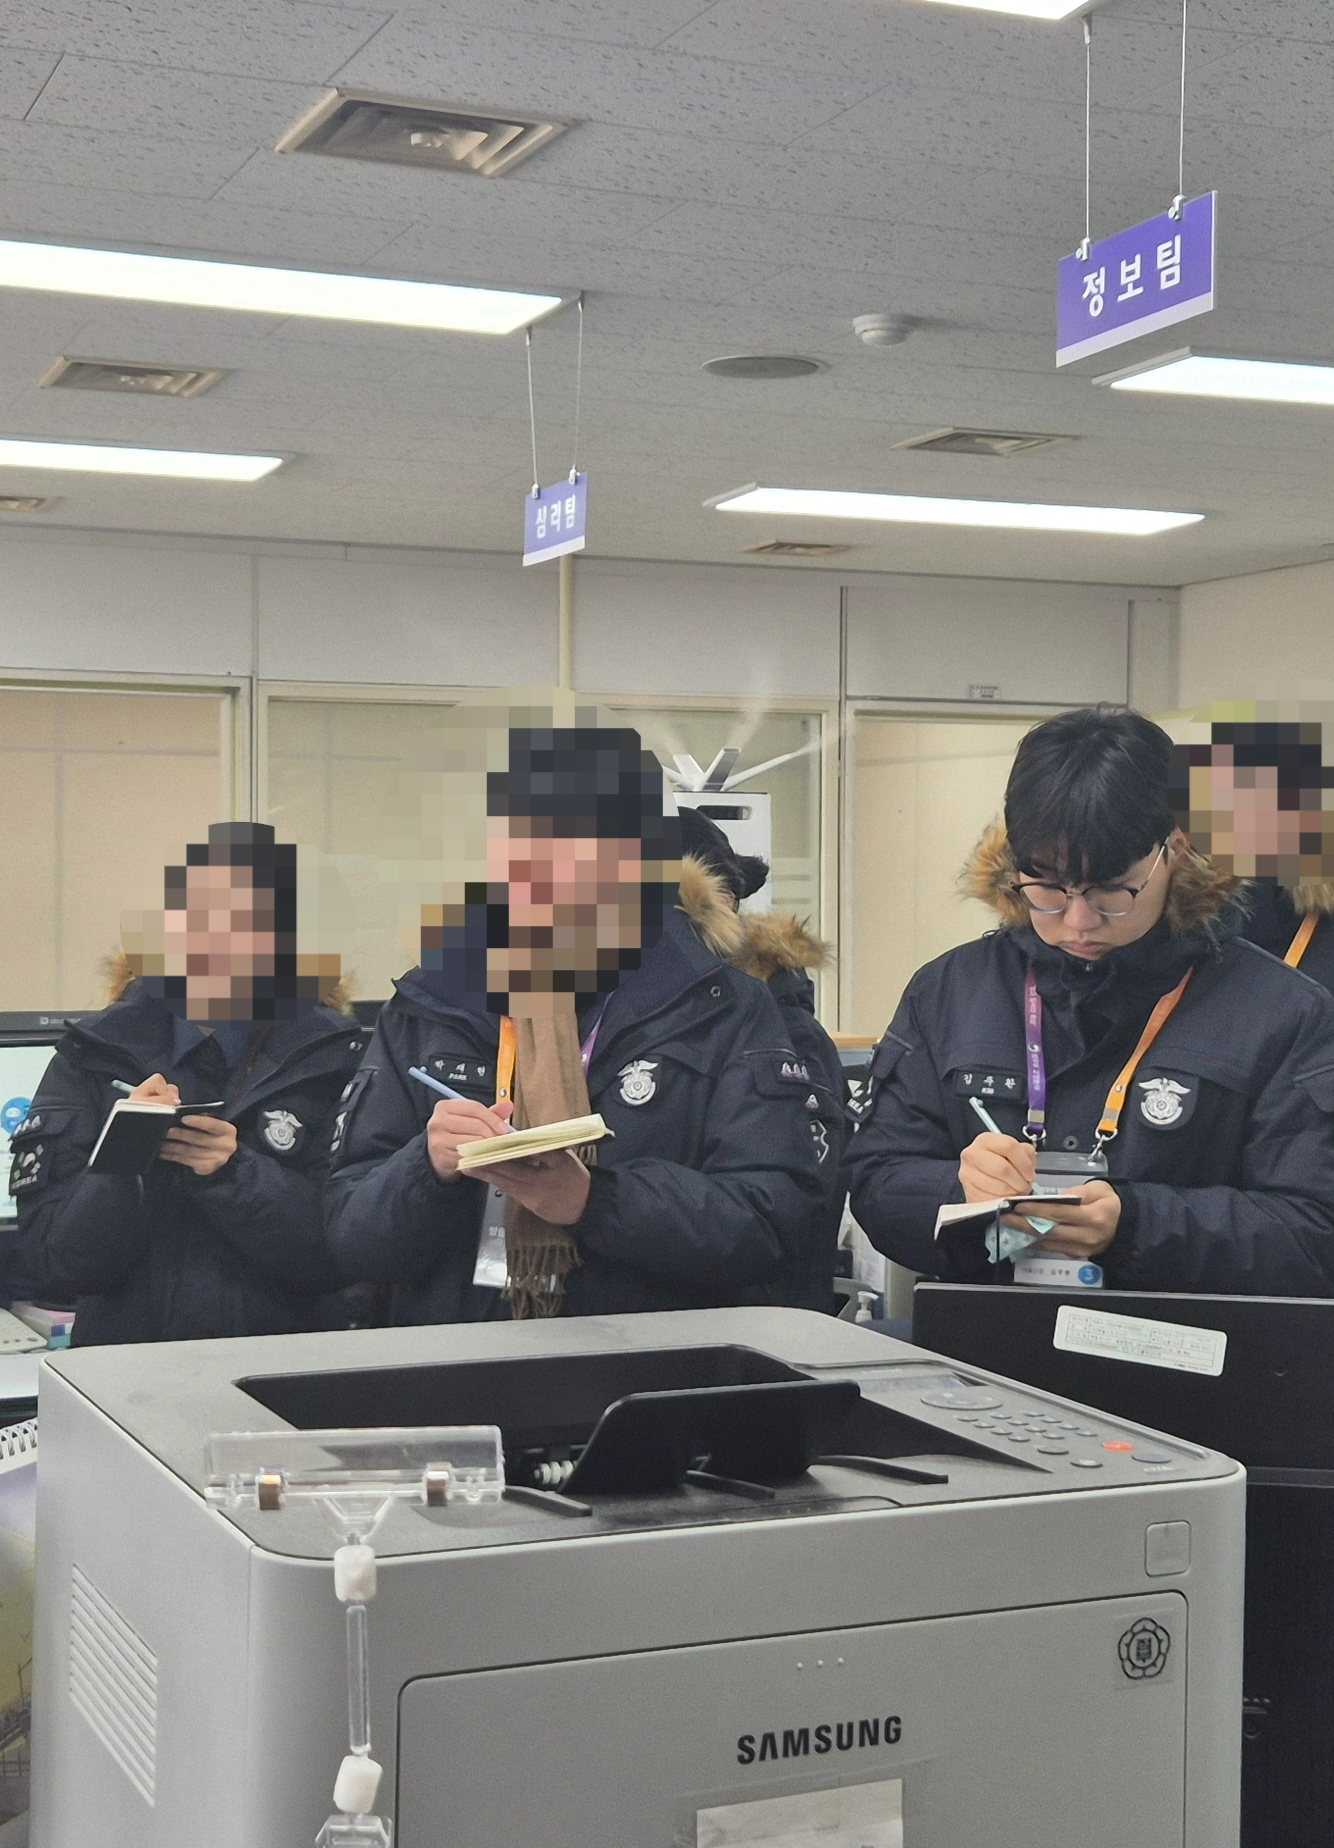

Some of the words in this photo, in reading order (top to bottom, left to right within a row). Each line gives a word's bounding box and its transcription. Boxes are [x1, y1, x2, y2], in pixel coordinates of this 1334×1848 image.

[1082, 235, 1182, 317] 정보팀
[535, 494, 576, 539] 심리팀
[1085, 1268, 1094, 1280] 3
[737, 1715, 902, 1765] SAMSUNG
